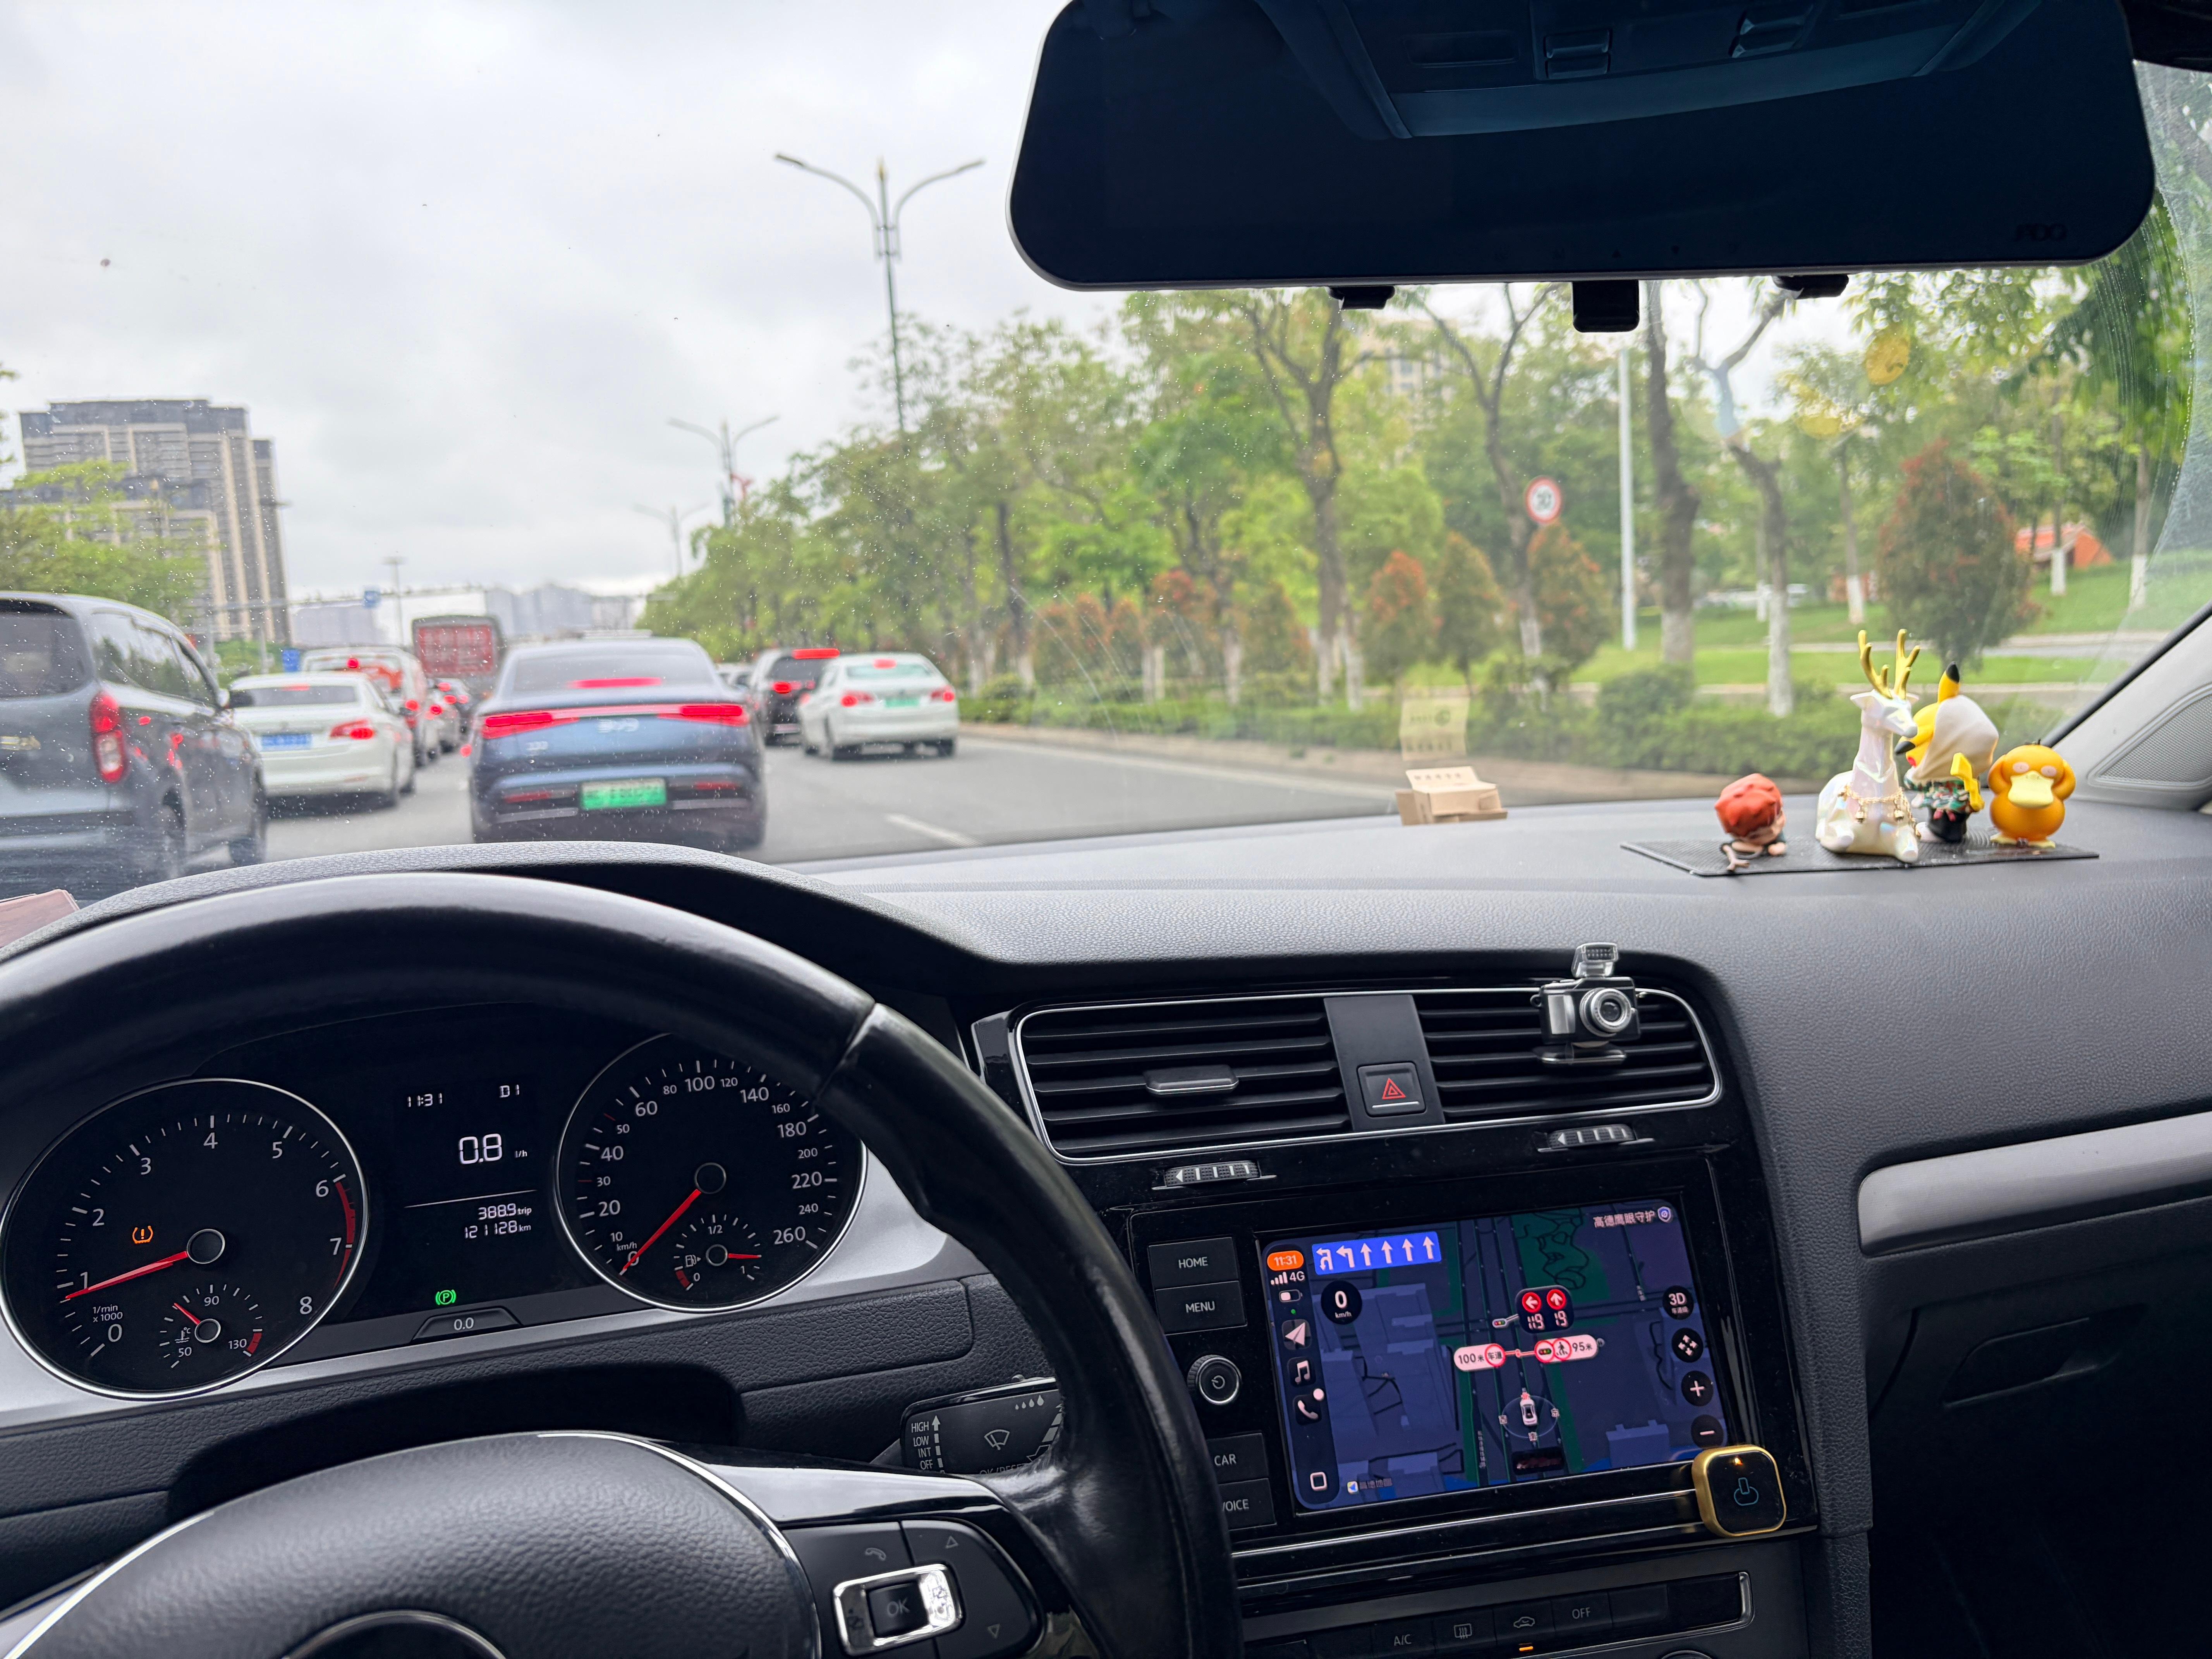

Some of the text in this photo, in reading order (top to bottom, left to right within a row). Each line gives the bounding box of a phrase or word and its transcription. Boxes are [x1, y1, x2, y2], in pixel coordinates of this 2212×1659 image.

[685, 1076, 714, 1092] 100
[721, 1077, 738, 1087] 120
[663, 1085, 677, 1094] 80
[740, 1087, 769, 1103] 140
[407, 1093, 442, 1107] 11:31
[635, 1101, 657, 1116] 60
[772, 1103, 790, 1113] 160
[617, 1124, 629, 1134] 50
[778, 1121, 807, 1138] 180
[204, 1133, 218, 1149] 4
[273, 1142, 282, 1158] 5
[459, 1133, 502, 1164] 0.8
[601, 1146, 623, 1161] 40
[798, 1148, 817, 1158] 200
[141, 1158, 151, 1175] 3
[597, 1176, 610, 1187] 30
[792, 1172, 822, 1189] 220
[316, 1180, 328, 1197] 6
[478, 1203, 531, 1220] 388.9 trip
[599, 1200, 620, 1216] 20
[799, 1203, 818, 1214] 240
[93, 1209, 104, 1226] 2
[465, 1221, 517, 1238] 121128
[708, 1225, 723, 1234] 1/2
[774, 1226, 806, 1245] 260
[611, 1232, 622, 1242] 10
[330, 1238, 341, 1255] 7
[617, 1241, 638, 1251] km/h
[627, 1250, 639, 1266] 0
[1179, 1257, 1208, 1268] HOME
[1273, 1255, 1297, 1266] 11:31
[80, 1272, 89, 1290] 1
[694, 1273, 700, 1281] 0
[1290, 1271, 1305, 1281] 4G
[204, 1296, 219, 1306] 90
[1335, 1291, 1347, 1308] 0
[1669, 1293, 1686, 1305] 3D
[93, 1304, 118, 1314] 1/min
[300, 1297, 312, 1314] 8
[1186, 1301, 1215, 1312] MENU
[101, 1312, 123, 1321] 1000
[1554, 1311, 1568, 1327] 19
[454, 1317, 474, 1330] 0.0
[108, 1324, 122, 1342] 0
[228, 1339, 247, 1350] 130
[1572, 1342, 1592, 1352] 95米
[179, 1347, 192, 1357] 50
[1488, 1352, 1502, 1360] 车道
[1458, 1353, 1485, 1364] 100米
[912, 1421, 929, 1432] HIGH
[913, 1436, 929, 1447] LOW
[918, 1448, 931, 1458] INT
[920, 1460, 934, 1470] OFF
[1214, 1454, 1236, 1466] CAR
[888, 1598, 910, 1616] OK
[1572, 1607, 1591, 1619] OFF
[1394, 1634, 1412, 1646] A/C
